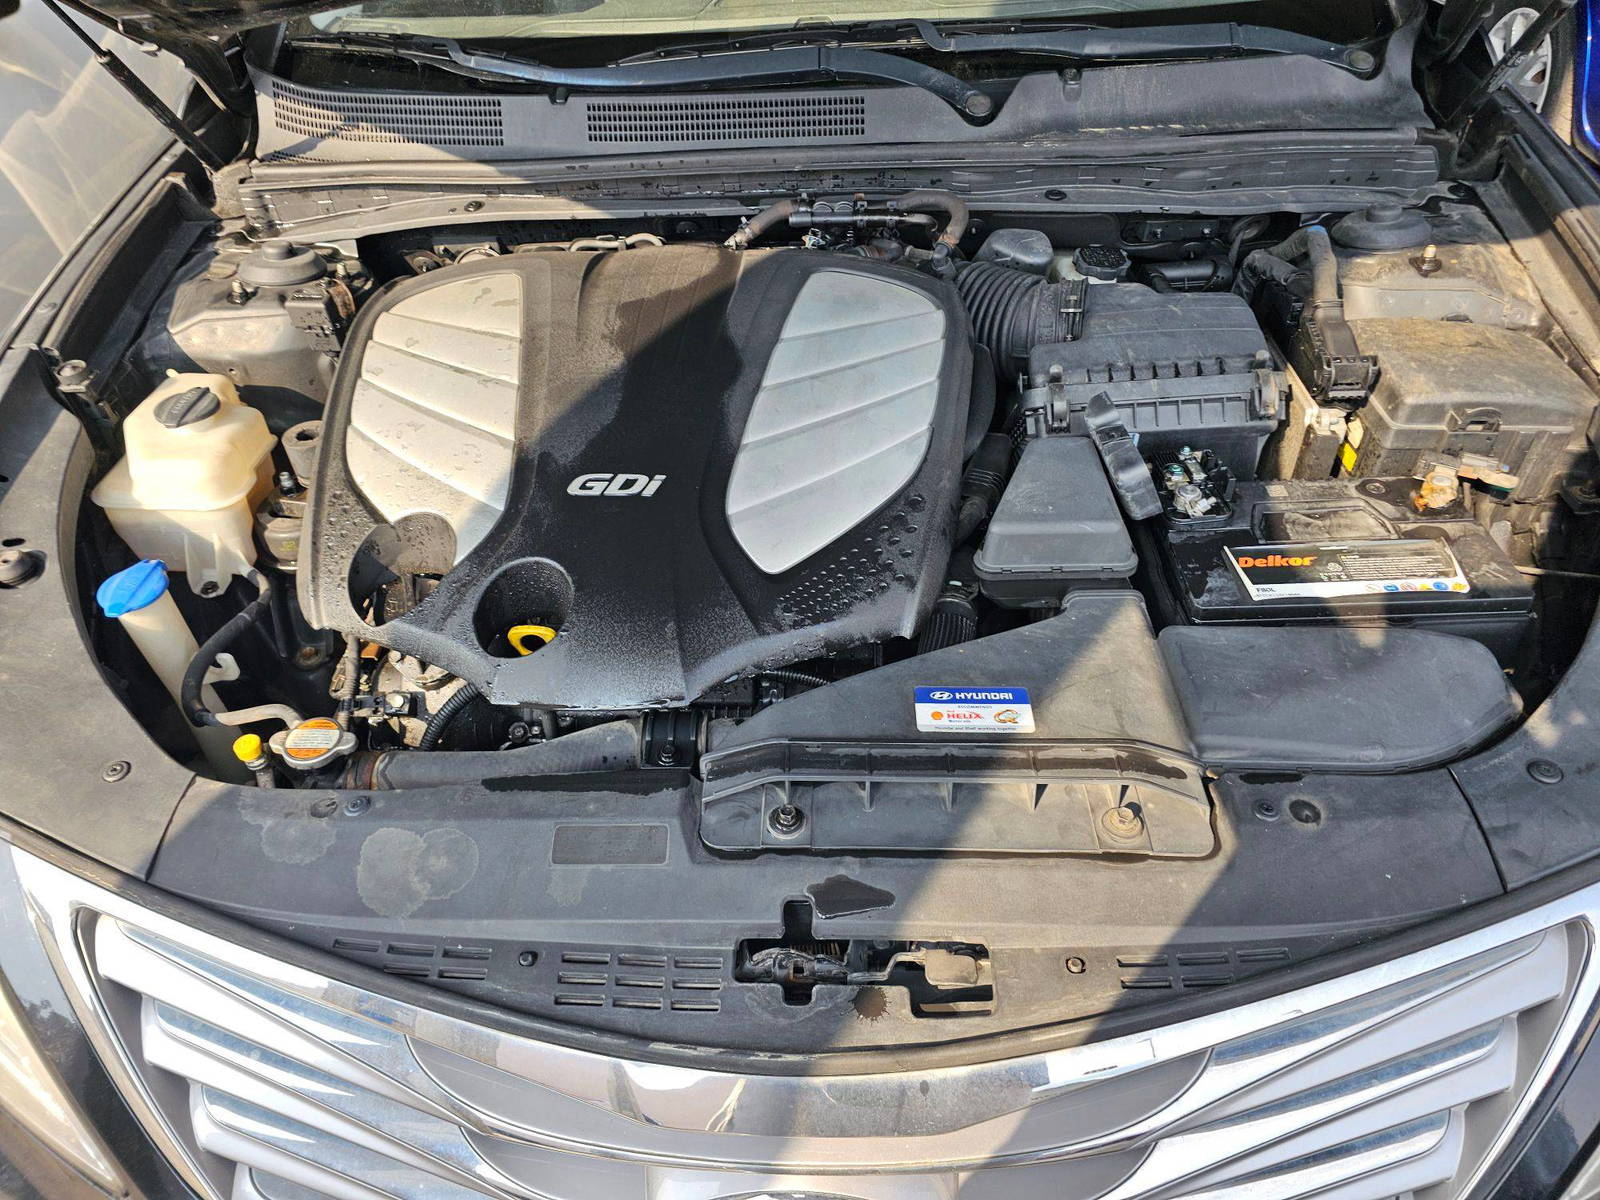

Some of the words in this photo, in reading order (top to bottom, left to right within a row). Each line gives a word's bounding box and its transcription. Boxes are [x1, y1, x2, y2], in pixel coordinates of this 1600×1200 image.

[566, 473, 667, 497] GDi
[1238, 555, 1317, 568] Delkor
[956, 692, 1013, 700] HYUNDAI
